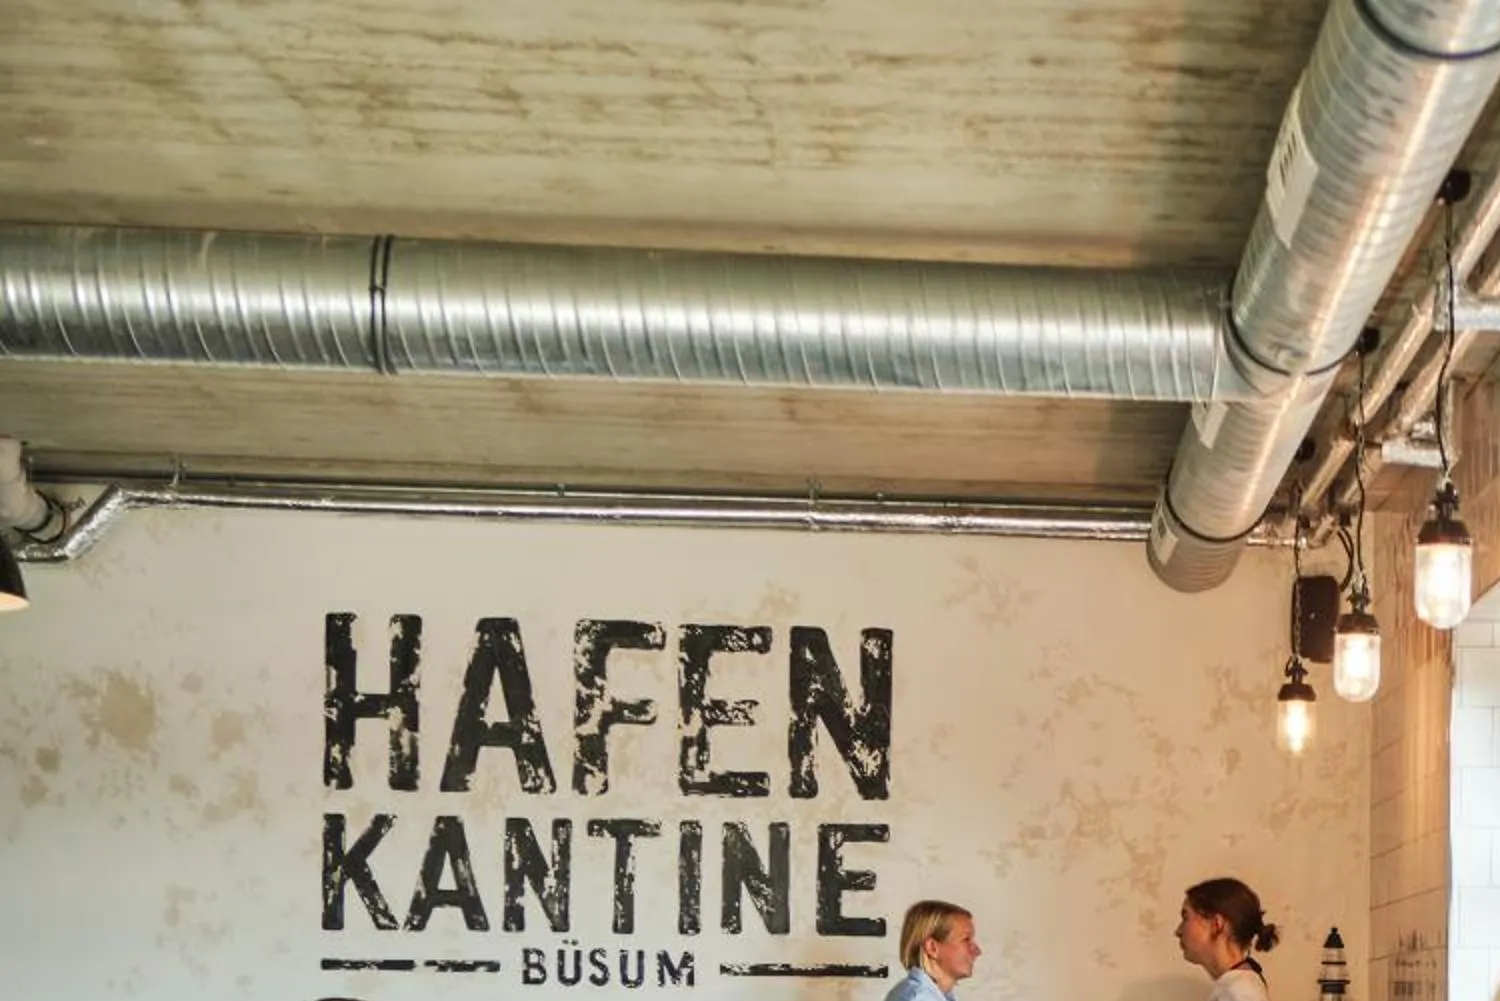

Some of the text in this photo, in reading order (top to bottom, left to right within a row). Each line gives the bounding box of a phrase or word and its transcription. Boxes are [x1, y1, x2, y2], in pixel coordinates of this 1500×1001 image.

[323, 612, 894, 801] HAFEN
[321, 813, 890, 937] KANTINE
[521, 939, 696, 989] BÜSUM
